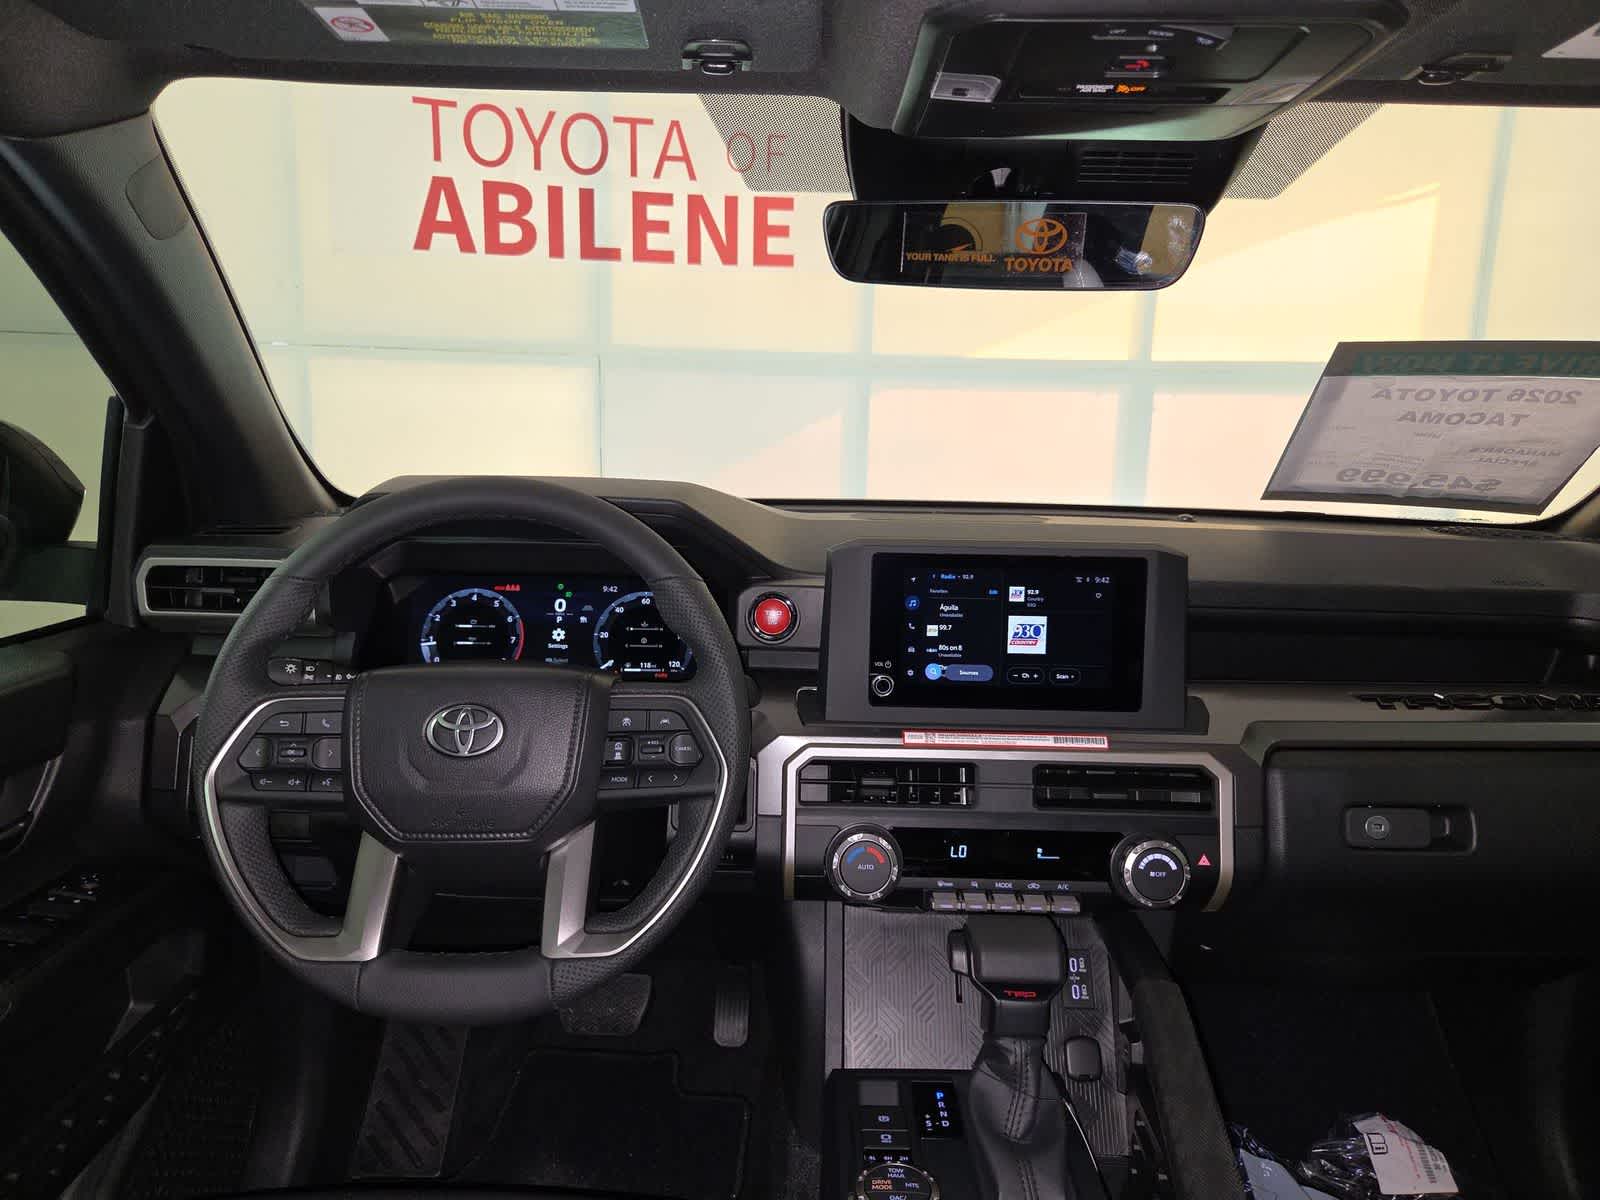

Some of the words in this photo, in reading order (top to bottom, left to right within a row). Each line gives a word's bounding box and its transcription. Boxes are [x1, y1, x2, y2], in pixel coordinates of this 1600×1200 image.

[412, 96, 697, 181] TOYOTA
[727, 130, 790, 174] OF
[413, 175, 795, 268] ABILENE
[905, 251, 932, 261] YOUR
[1004, 256, 1073, 272] TOYOTA
[1094, 576, 1110, 584] 9:42
[602, 585, 619, 593] 9:42
[554, 598, 567, 612] 0
[641, 597, 651, 605] 60
[615, 606, 624, 614] 40
[435, 614, 441, 622] 2
[506, 615, 513, 623] 6
[599, 631, 608, 639] 20
[510, 636, 516, 644] 7
[950, 844, 967, 858] LO
[995, 881, 1012, 889] MODE
[1057, 882, 1069, 890] A/C
[936, 1091, 944, 1099] P
